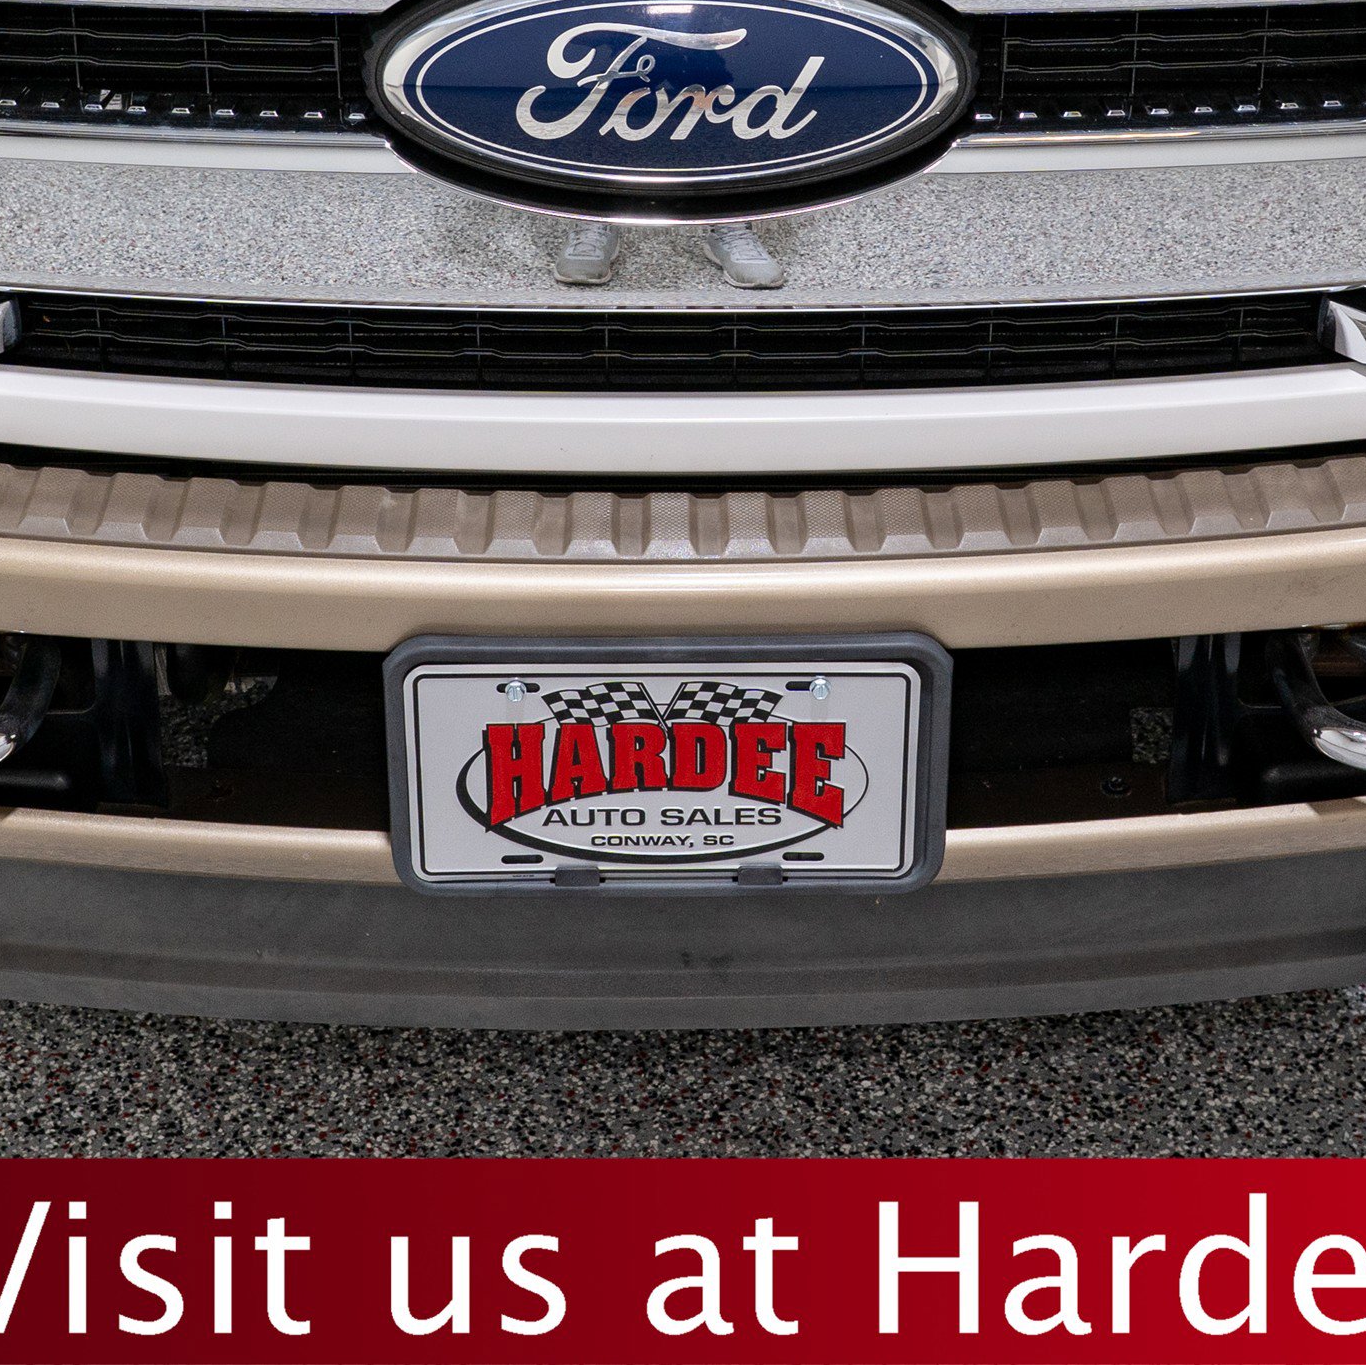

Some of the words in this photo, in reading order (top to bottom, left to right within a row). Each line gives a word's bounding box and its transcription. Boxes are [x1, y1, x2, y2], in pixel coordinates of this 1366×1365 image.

[516, 22, 825, 141] Ford
[482, 722, 848, 831] HARDEE
[541, 808, 646, 827] AUTO
[660, 807, 782, 827] SALES
[590, 835, 694, 849] CONWAY,
[703, 835, 735, 846] SC
